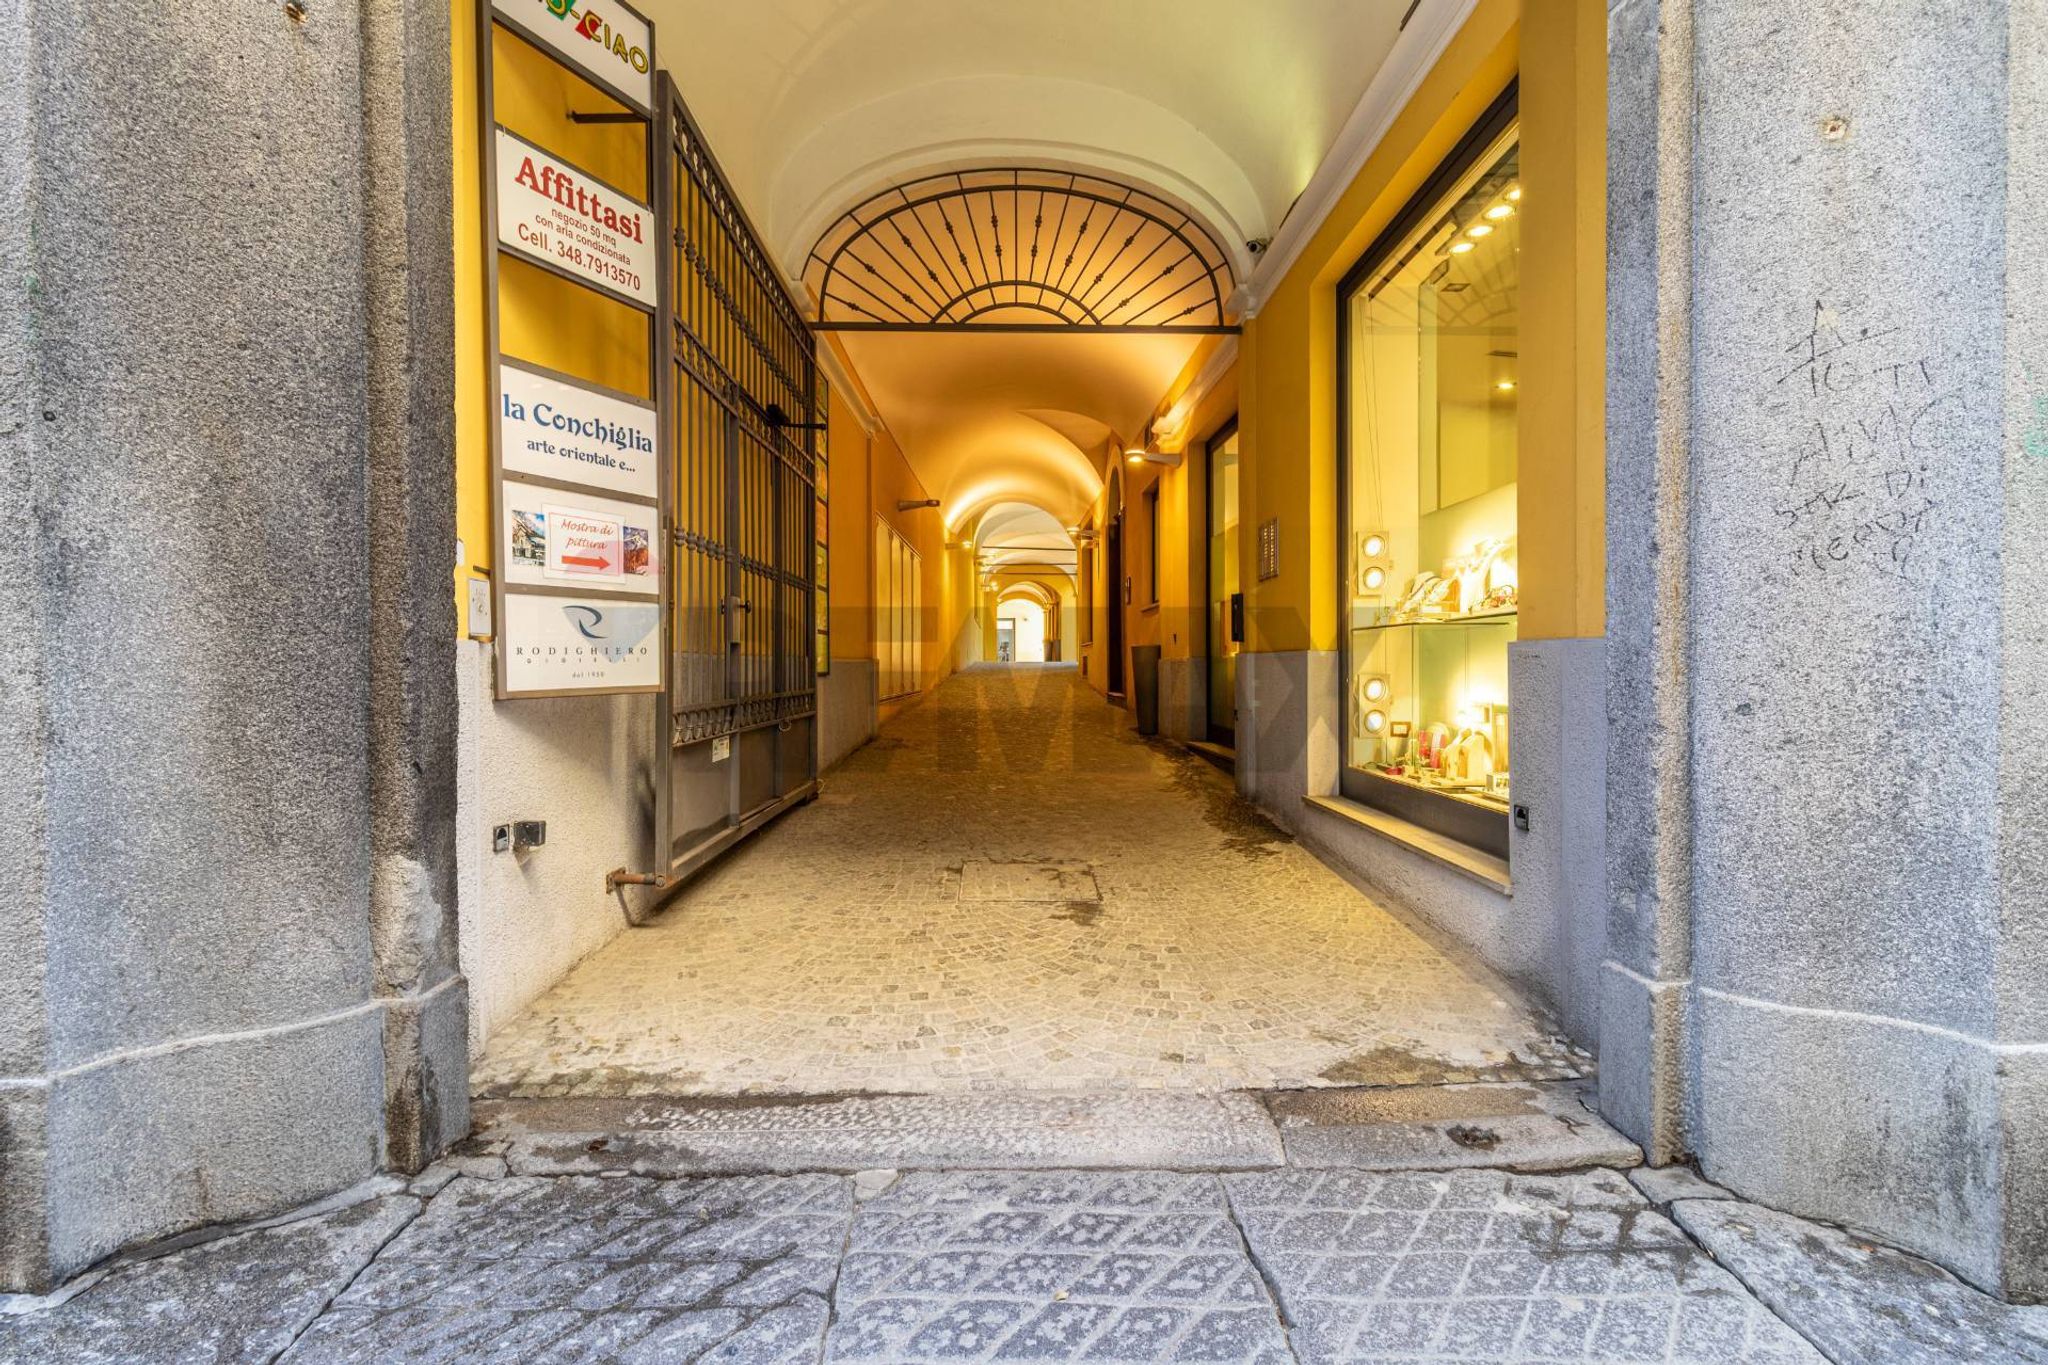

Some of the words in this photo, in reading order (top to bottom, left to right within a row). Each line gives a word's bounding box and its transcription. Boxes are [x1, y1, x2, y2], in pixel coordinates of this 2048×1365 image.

[514, 156, 643, 244] Affittasi
[535, 213, 554, 230] con
[556, 222, 574, 239] aria
[575, 231, 631, 266] condizionata
[552, 208, 588, 233] negozio
[590, 224, 601, 238] 50
[602, 232, 617, 248] mq
[518, 223, 552, 253] Cell.
[557, 240, 641, 291] 348.7913570
[503, 394, 525, 421] la
[533, 403, 653, 453] Conchiglia
[527, 440, 556, 455] arte
[559, 447, 616, 468] orientale
[619, 461, 636, 473] e...
[561, 519, 598, 534] Mostra
[600, 524, 614, 535] di
[565, 535, 609, 550] pittura
[516, 646, 648, 656] RODIGHIERO
